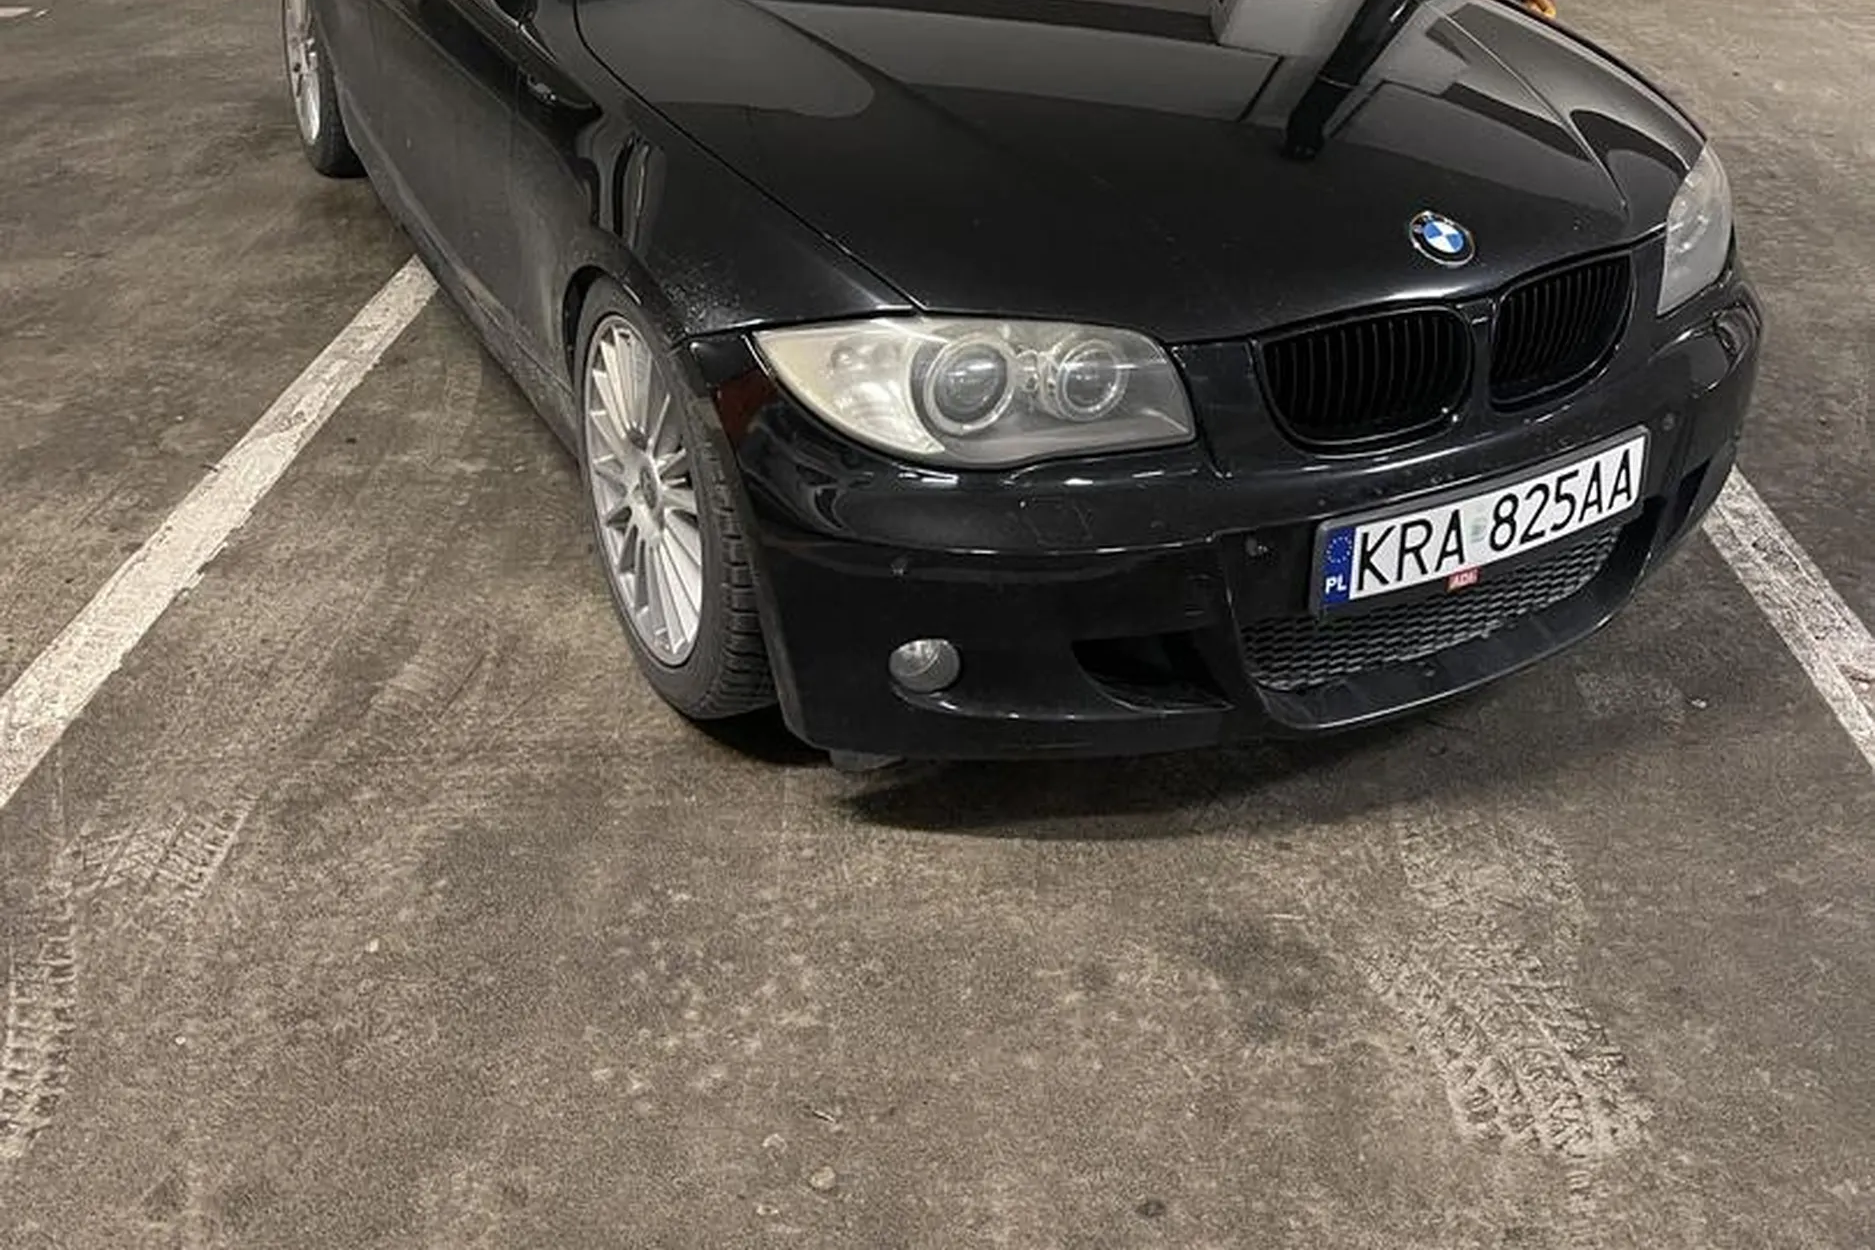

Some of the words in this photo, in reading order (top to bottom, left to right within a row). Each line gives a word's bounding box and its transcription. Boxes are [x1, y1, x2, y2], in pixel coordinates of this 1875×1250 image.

[1357, 508, 1465, 592] KRA
[1489, 449, 1633, 552] 825AA
[1325, 574, 1347, 595] PL
